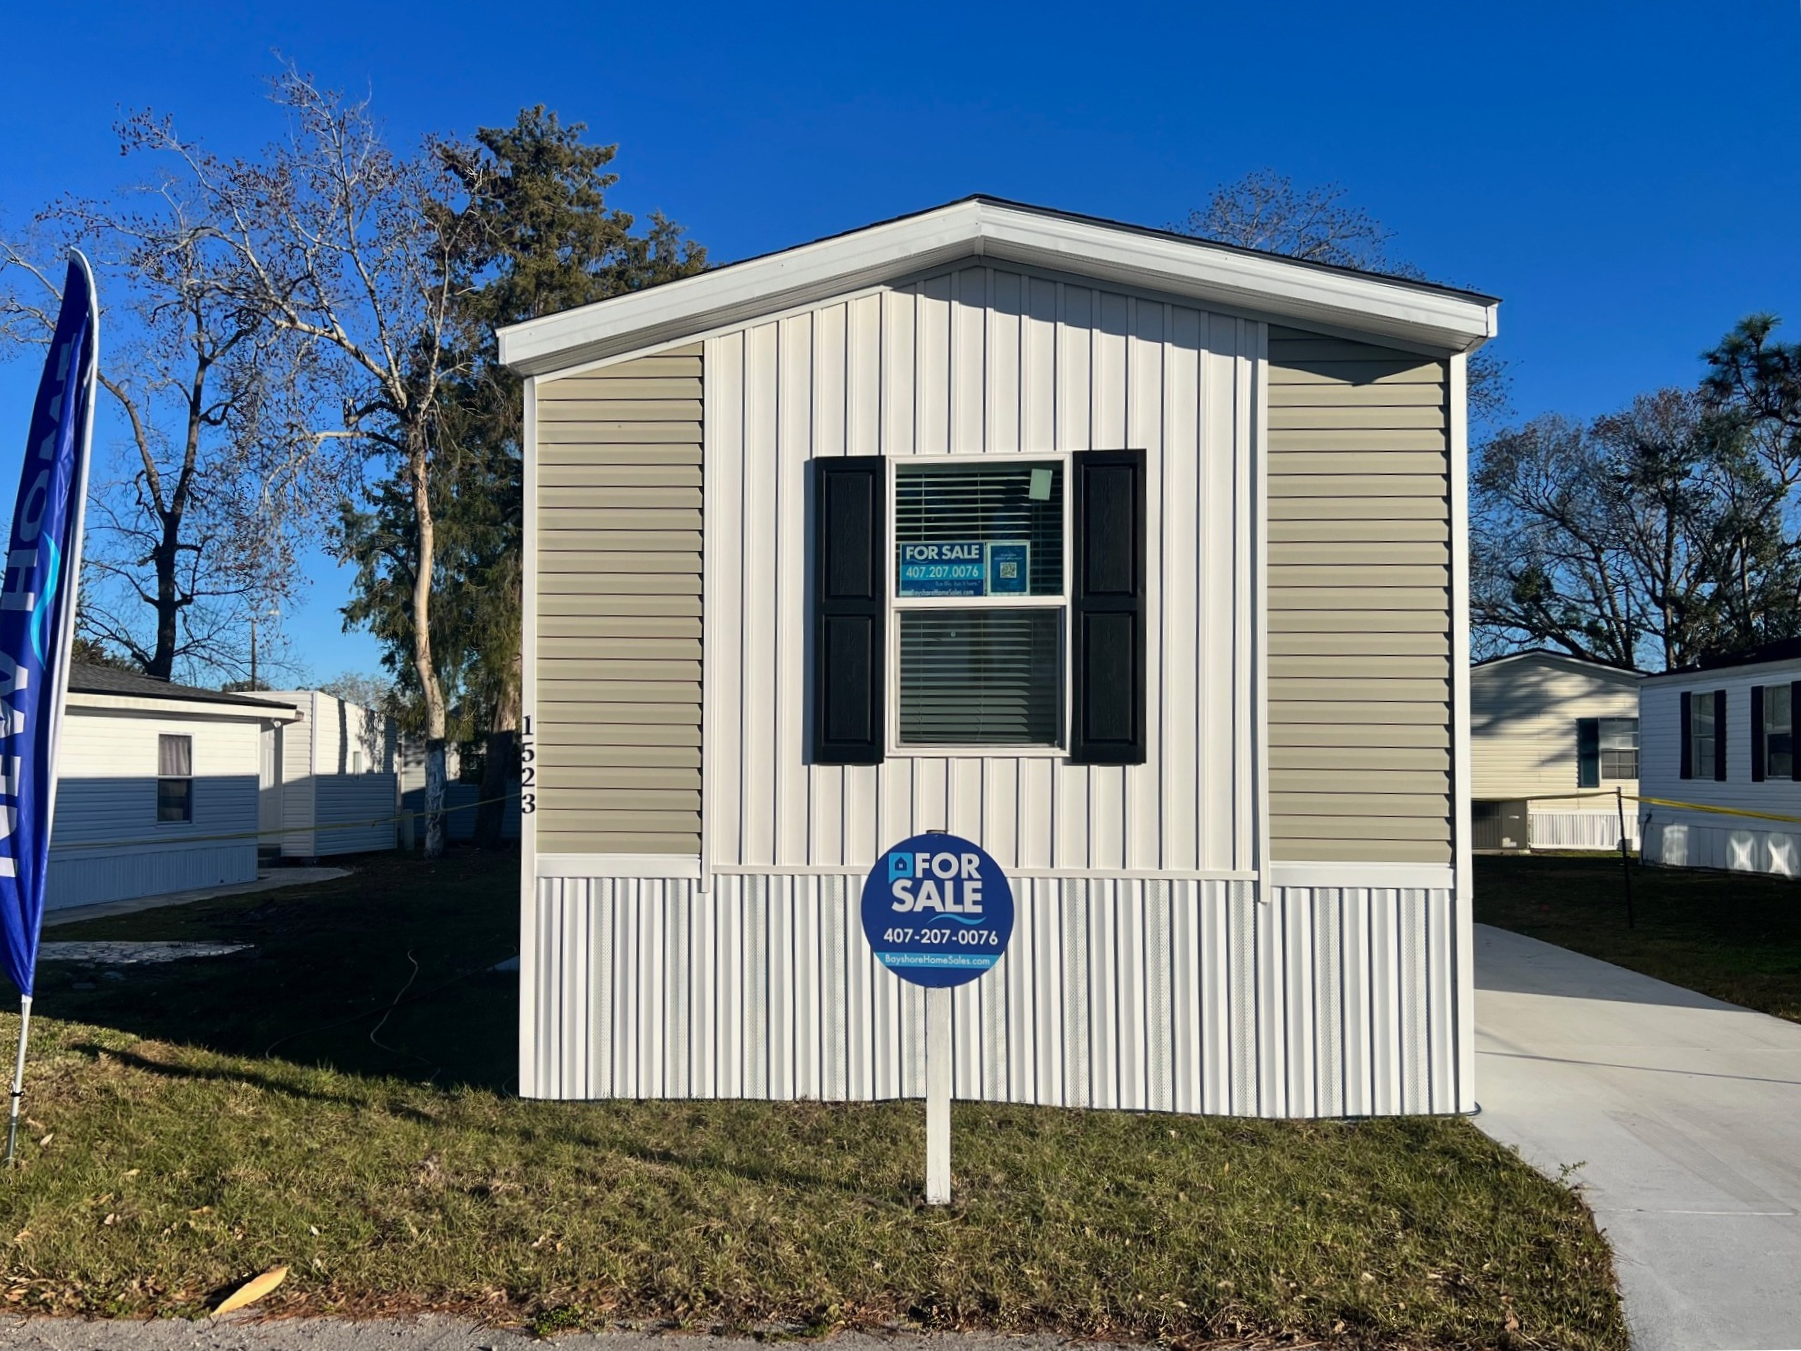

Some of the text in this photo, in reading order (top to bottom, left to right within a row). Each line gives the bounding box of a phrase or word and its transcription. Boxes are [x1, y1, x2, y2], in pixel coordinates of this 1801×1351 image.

[906, 545, 980, 560] FOR SALE
[905, 565, 979, 578] 407.207.0076
[521, 714, 536, 814] 1523
[915, 852, 982, 879] FOR
[891, 878, 983, 913] SALE
[883, 927, 999, 946] 407-207-0076
[885, 954, 990, 966] BayshoreHomeSales.com
